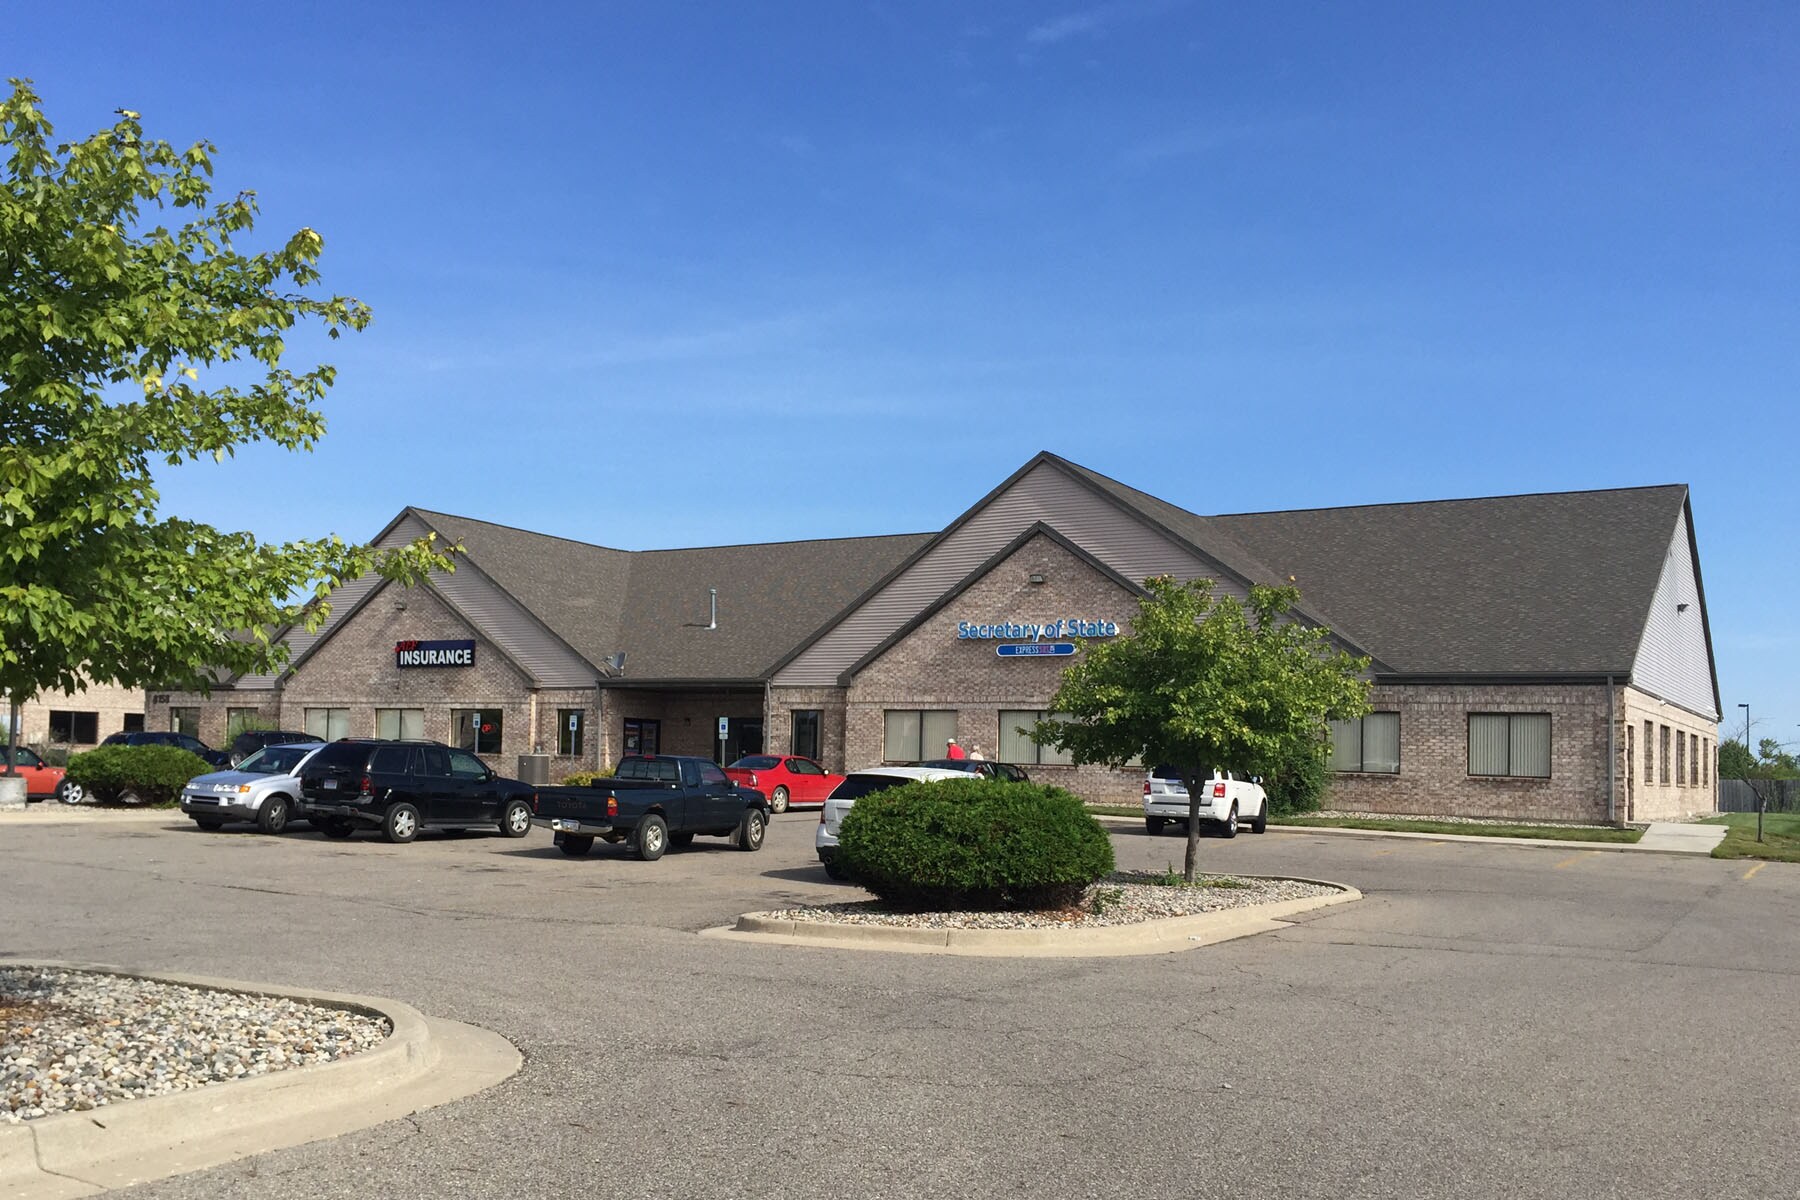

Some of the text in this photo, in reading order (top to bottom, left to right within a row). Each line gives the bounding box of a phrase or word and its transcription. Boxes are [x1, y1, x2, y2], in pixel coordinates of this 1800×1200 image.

[958, 618, 1119, 642] Secretary of State
[400, 649, 472, 665] INSURANCE
